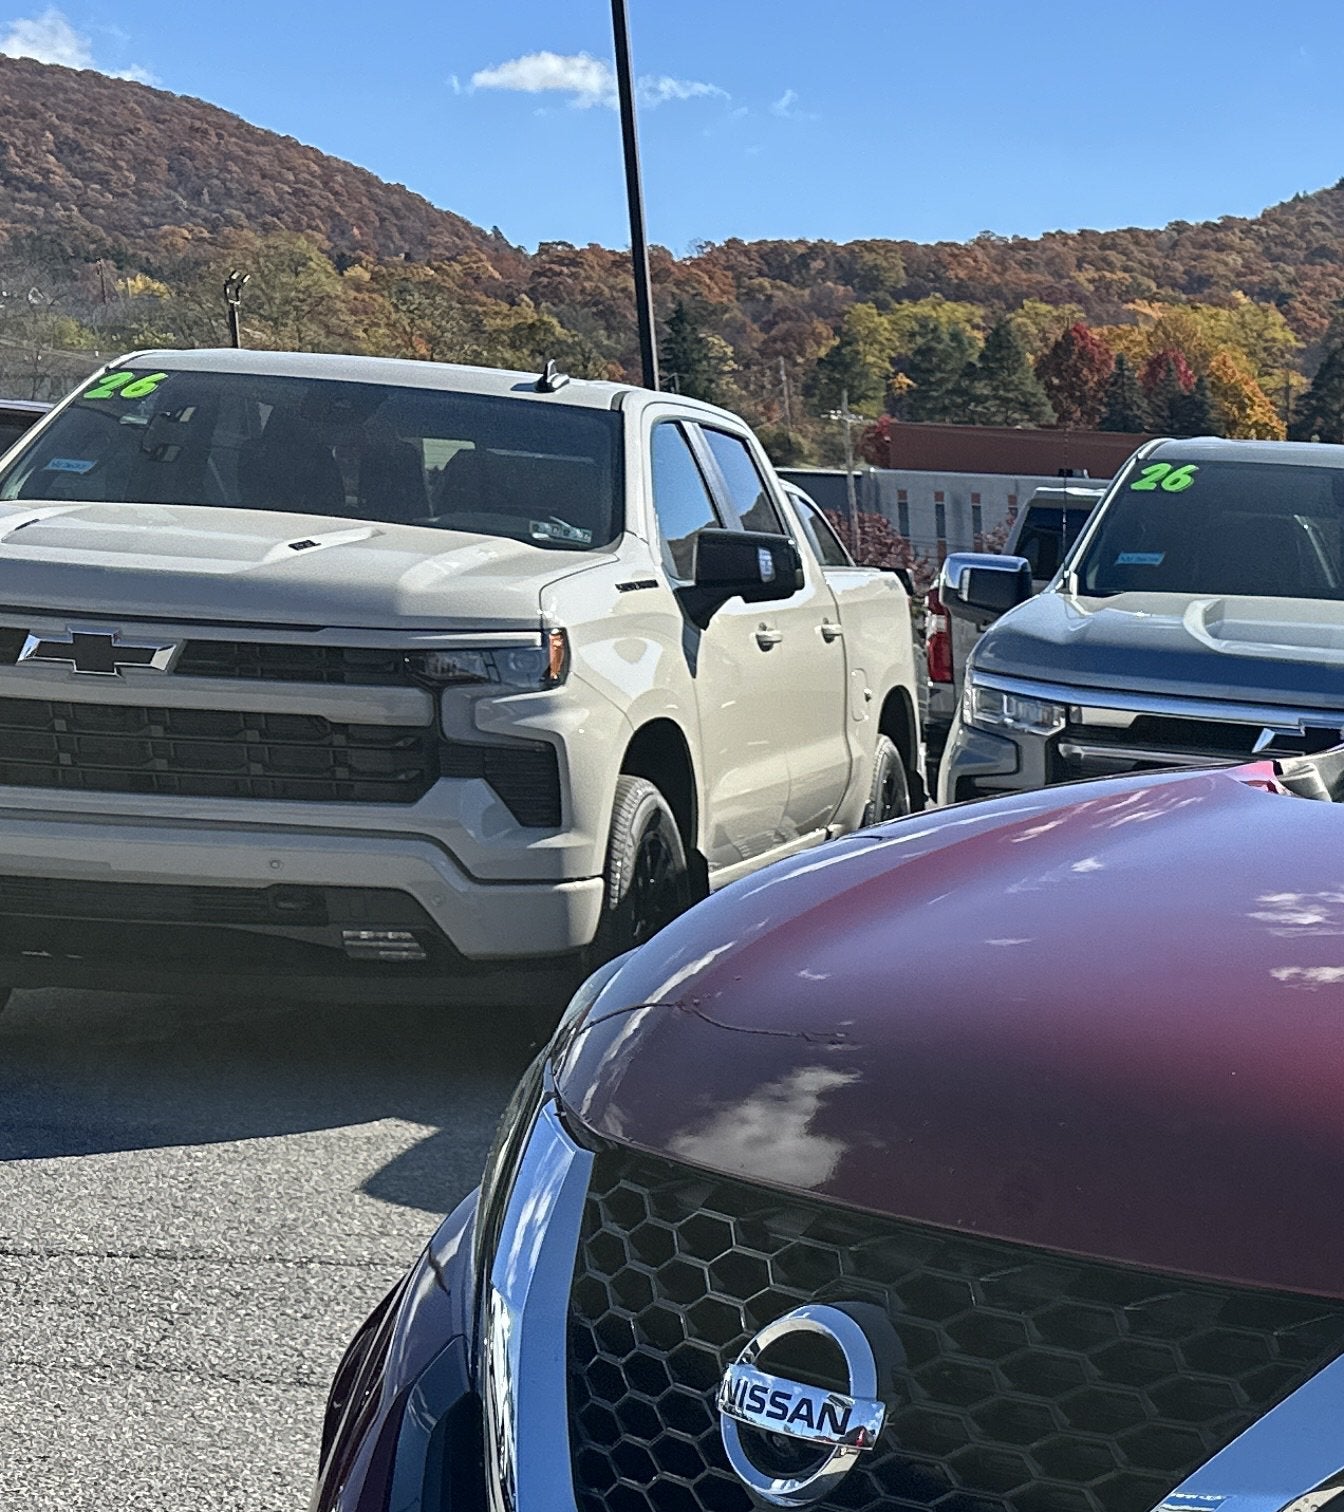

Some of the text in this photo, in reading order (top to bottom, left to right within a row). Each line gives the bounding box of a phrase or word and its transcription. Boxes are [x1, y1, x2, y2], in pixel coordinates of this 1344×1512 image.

[83, 371, 169, 399] 26
[1130, 462, 1199, 492] 26
[722, 1378, 853, 1436] NISSAN
